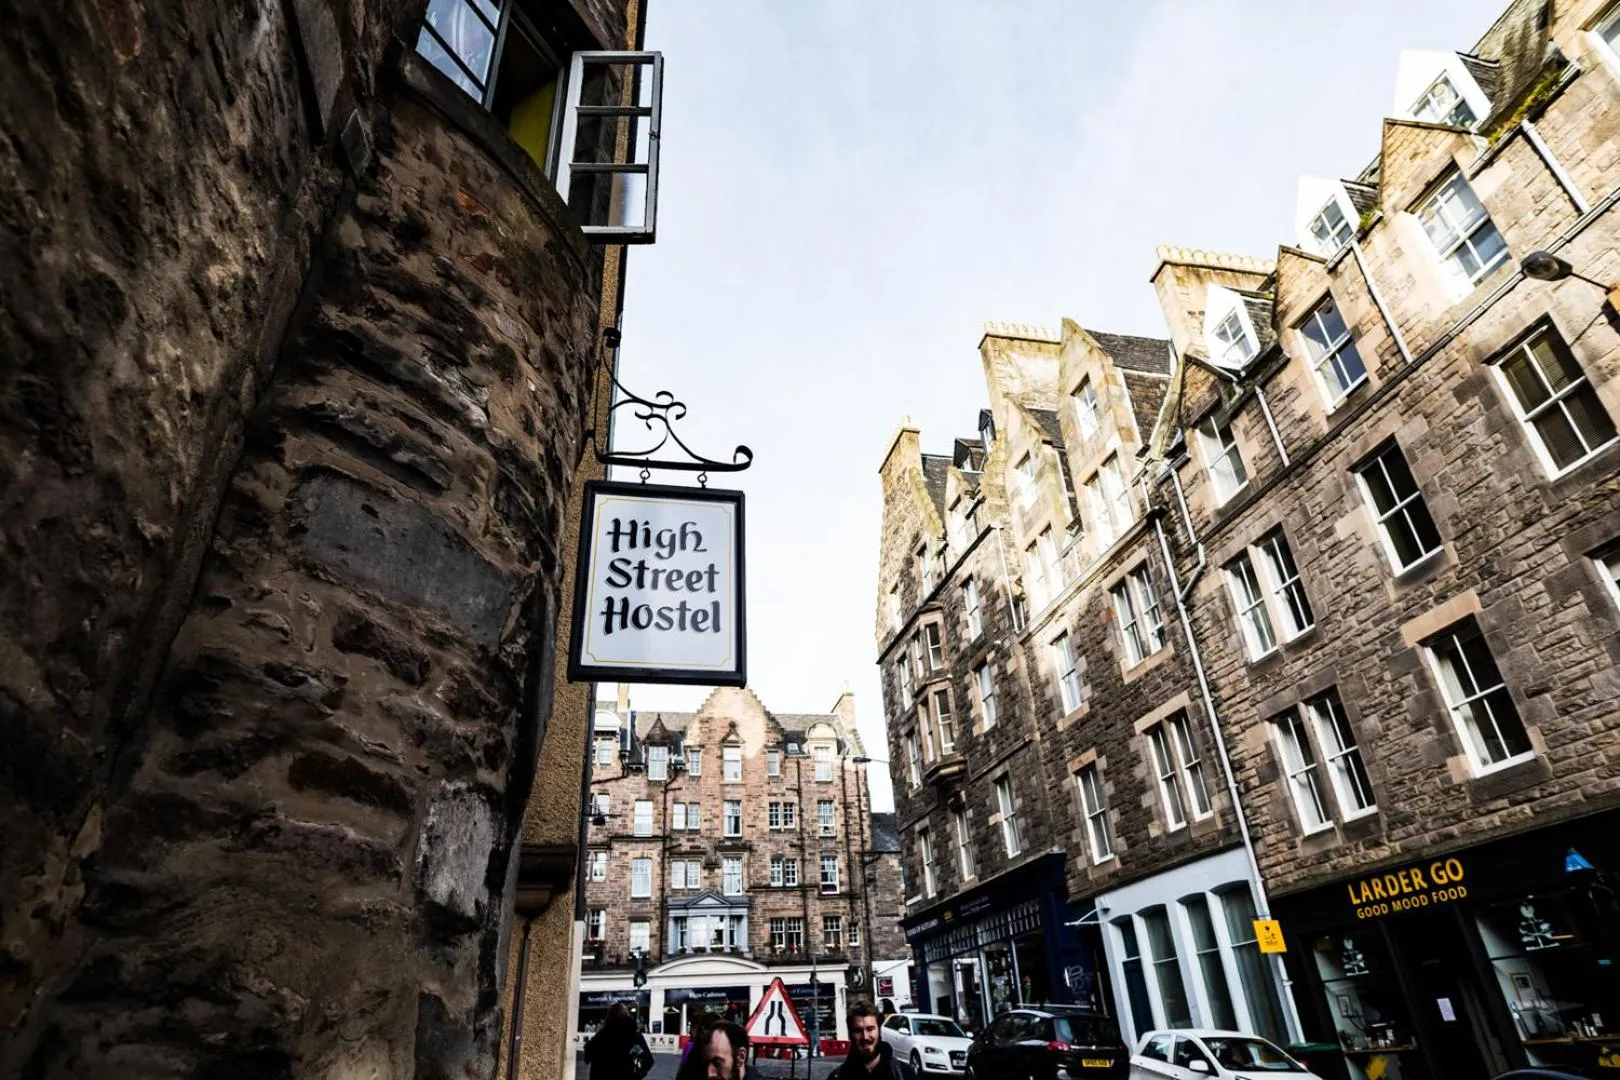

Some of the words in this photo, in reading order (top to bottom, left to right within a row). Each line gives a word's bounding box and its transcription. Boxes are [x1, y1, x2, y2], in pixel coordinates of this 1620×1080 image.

[606, 517, 708, 560] High
[604, 557, 720, 594] Street
[600, 595, 721, 636] Hostel
[1347, 867, 1429, 905] LARDER
[1430, 858, 1465, 885] GO
[1356, 903, 1389, 919] GOOD
[1391, 894, 1429, 913] MOOD
[1431, 885, 1467, 904] FOOD
